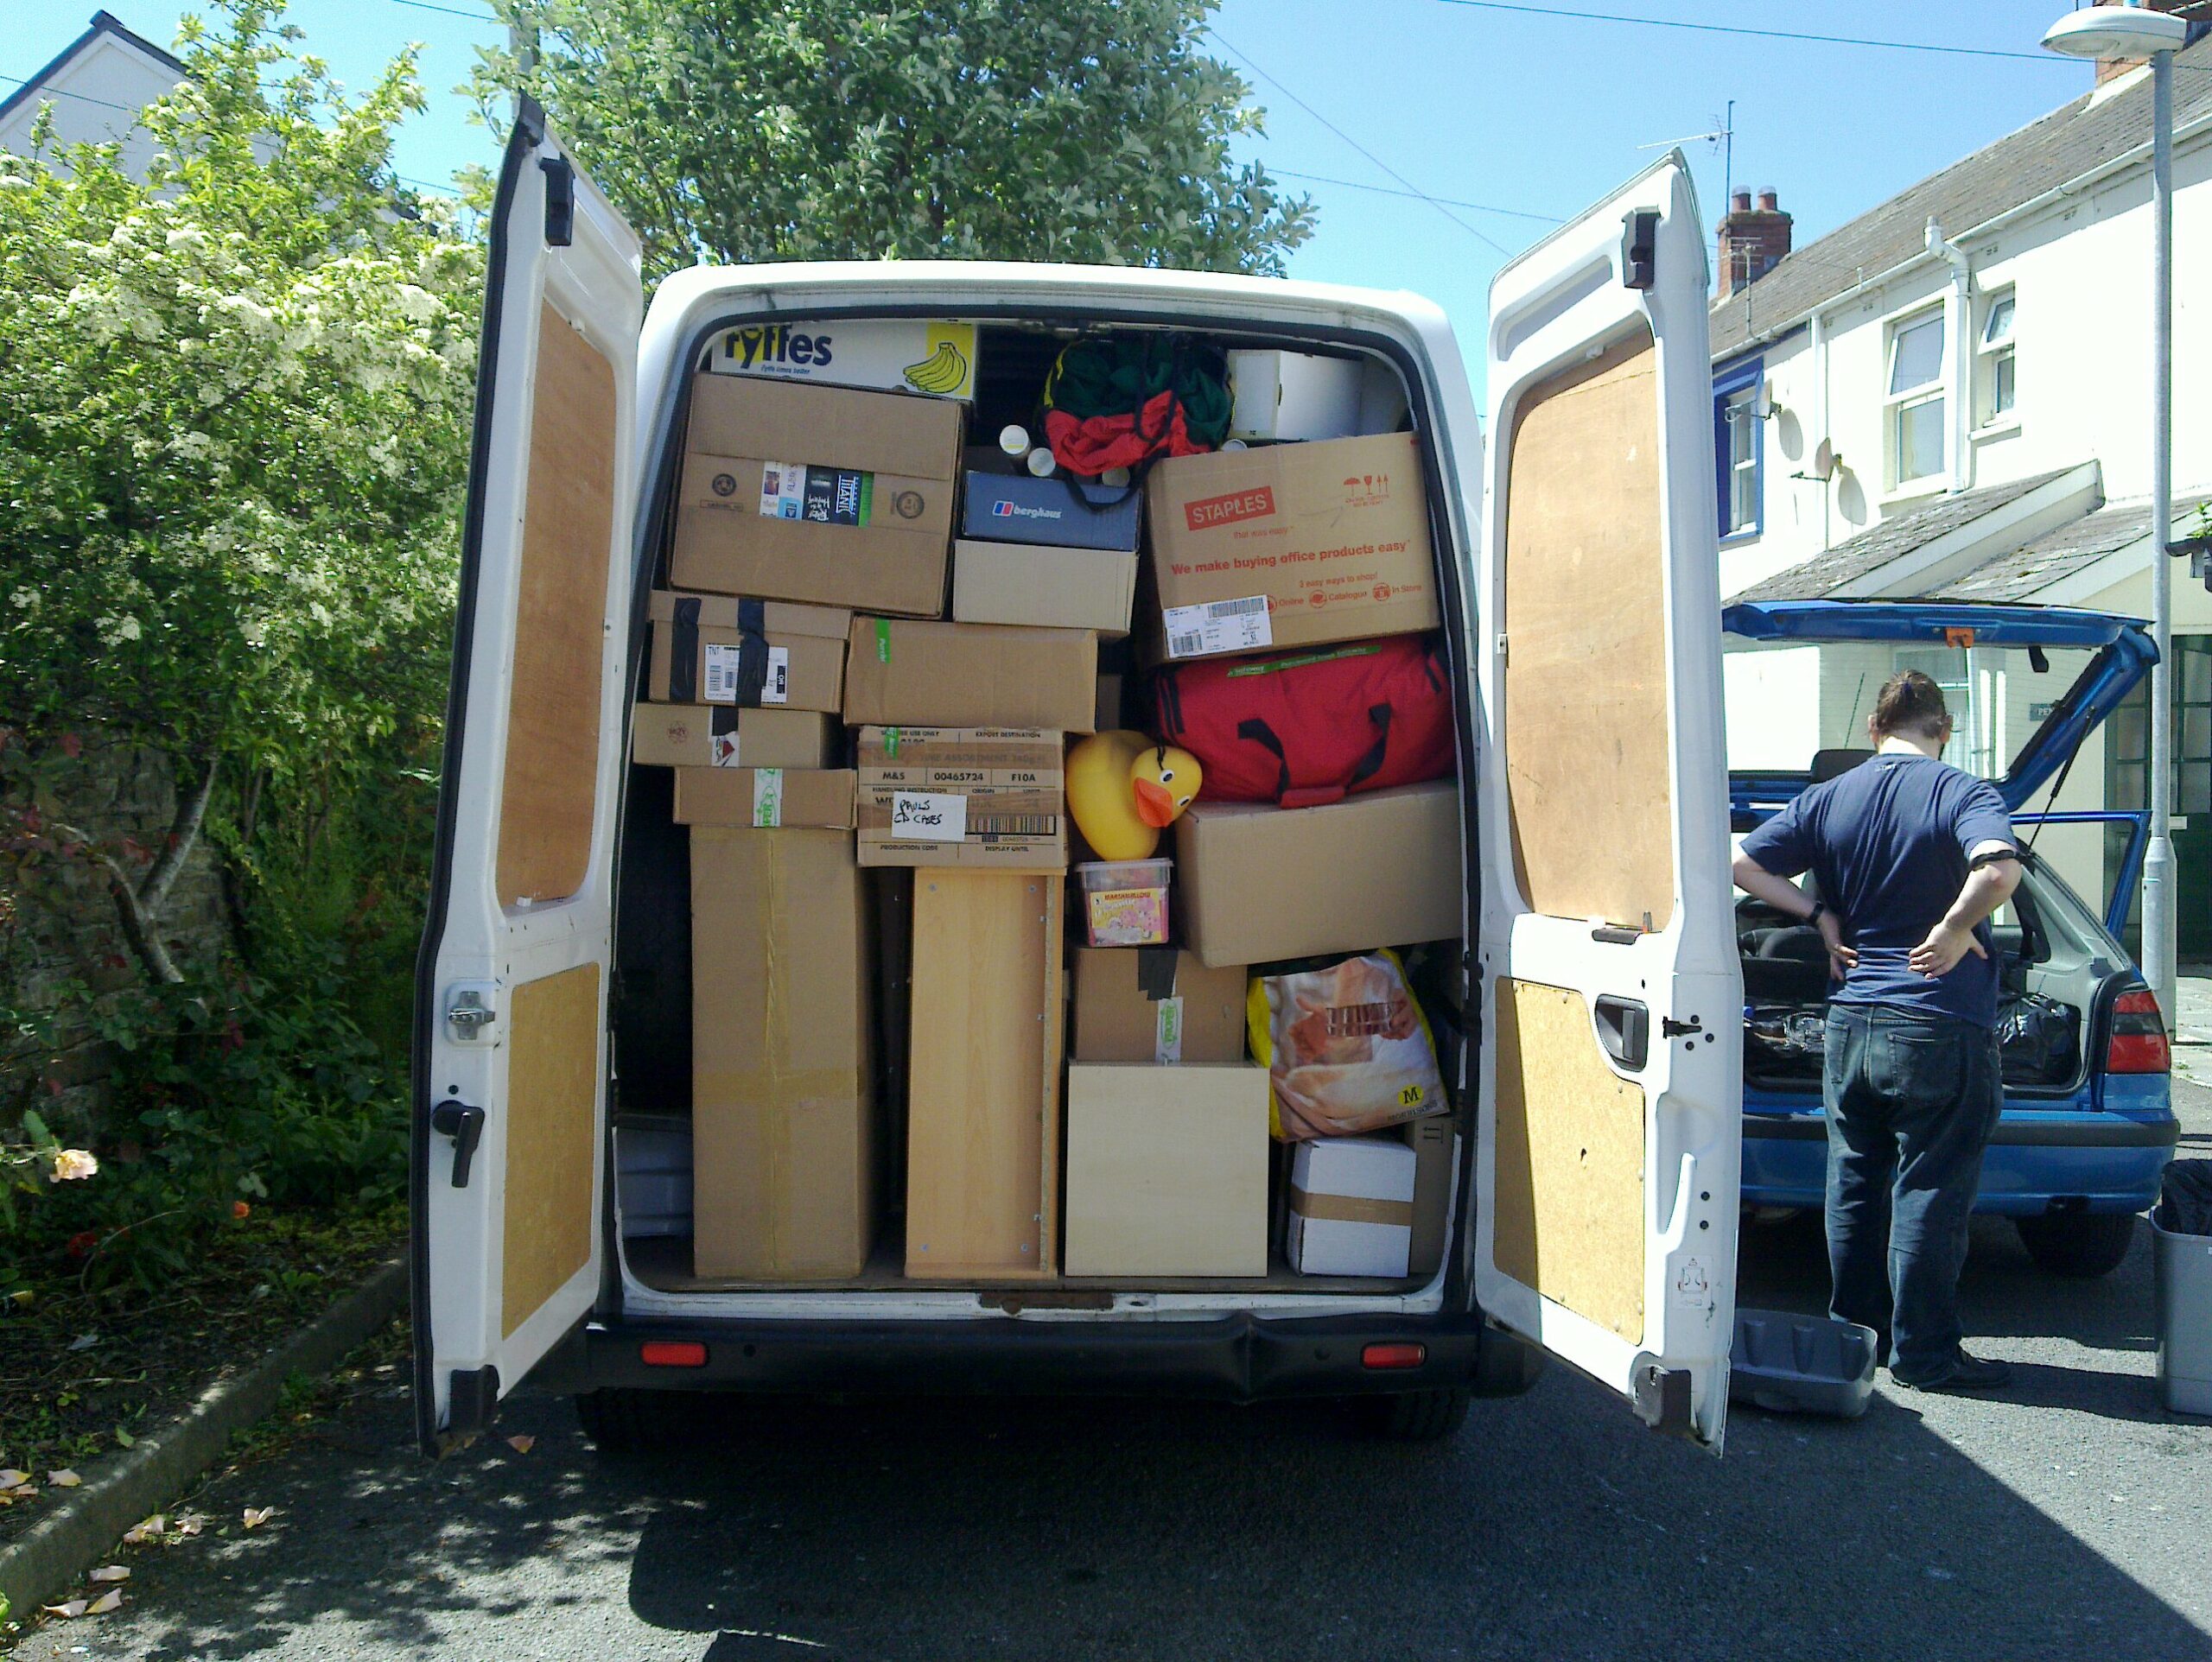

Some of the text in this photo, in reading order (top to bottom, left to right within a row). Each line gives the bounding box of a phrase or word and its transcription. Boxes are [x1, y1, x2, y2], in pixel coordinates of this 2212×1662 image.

[1014, 504, 1062, 518] berghaus
[1192, 493, 1268, 523] STAPLES
[1171, 541, 1407, 575] We make buying office products easy
[1306, 579, 1324, 588] easy
[1402, 584, 1422, 593] Store
[1279, 596, 1304, 607] Online
[882, 771, 906, 781] M&S
[934, 771, 984, 783] 00465724
[1011, 773, 1037, 783] F10A
[913, 814, 944, 825] CASES
[1402, 1086, 1420, 1105] M
